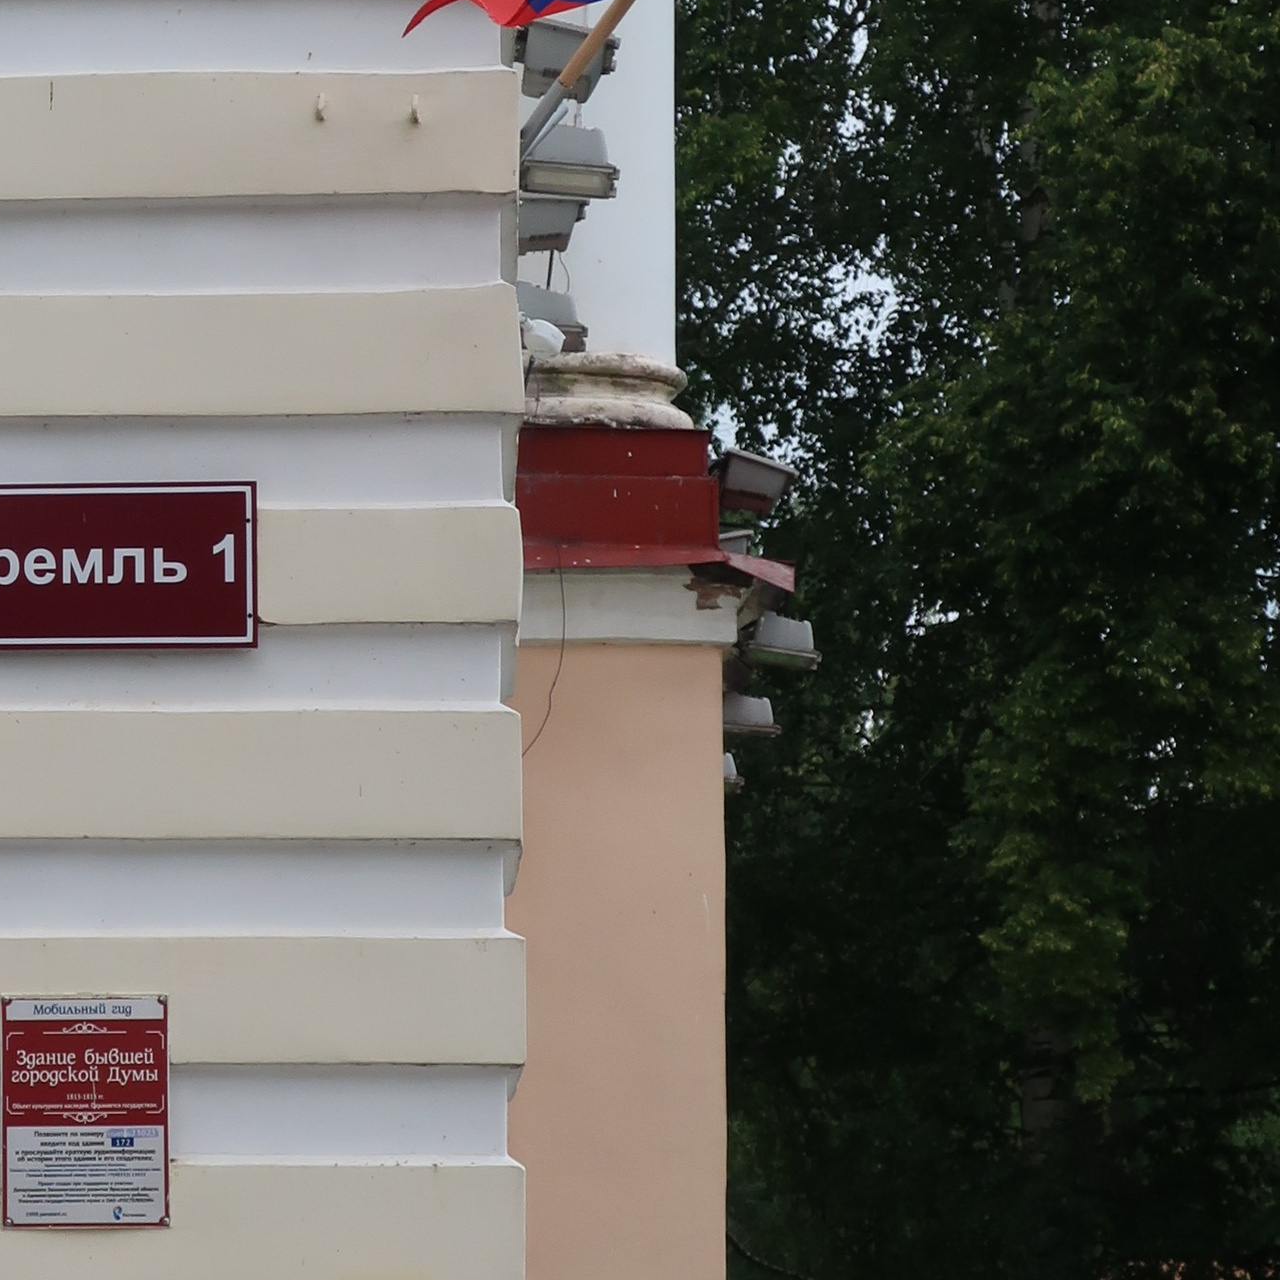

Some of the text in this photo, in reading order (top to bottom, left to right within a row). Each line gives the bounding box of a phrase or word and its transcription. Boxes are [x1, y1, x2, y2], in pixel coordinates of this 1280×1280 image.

[212, 533, 236, 583] 1
[33, 1004, 132, 1017] Мобильный гид
[16, 1048, 154, 1068] Здание бывшей
[11, 1066, 158, 1086] городской Думы
